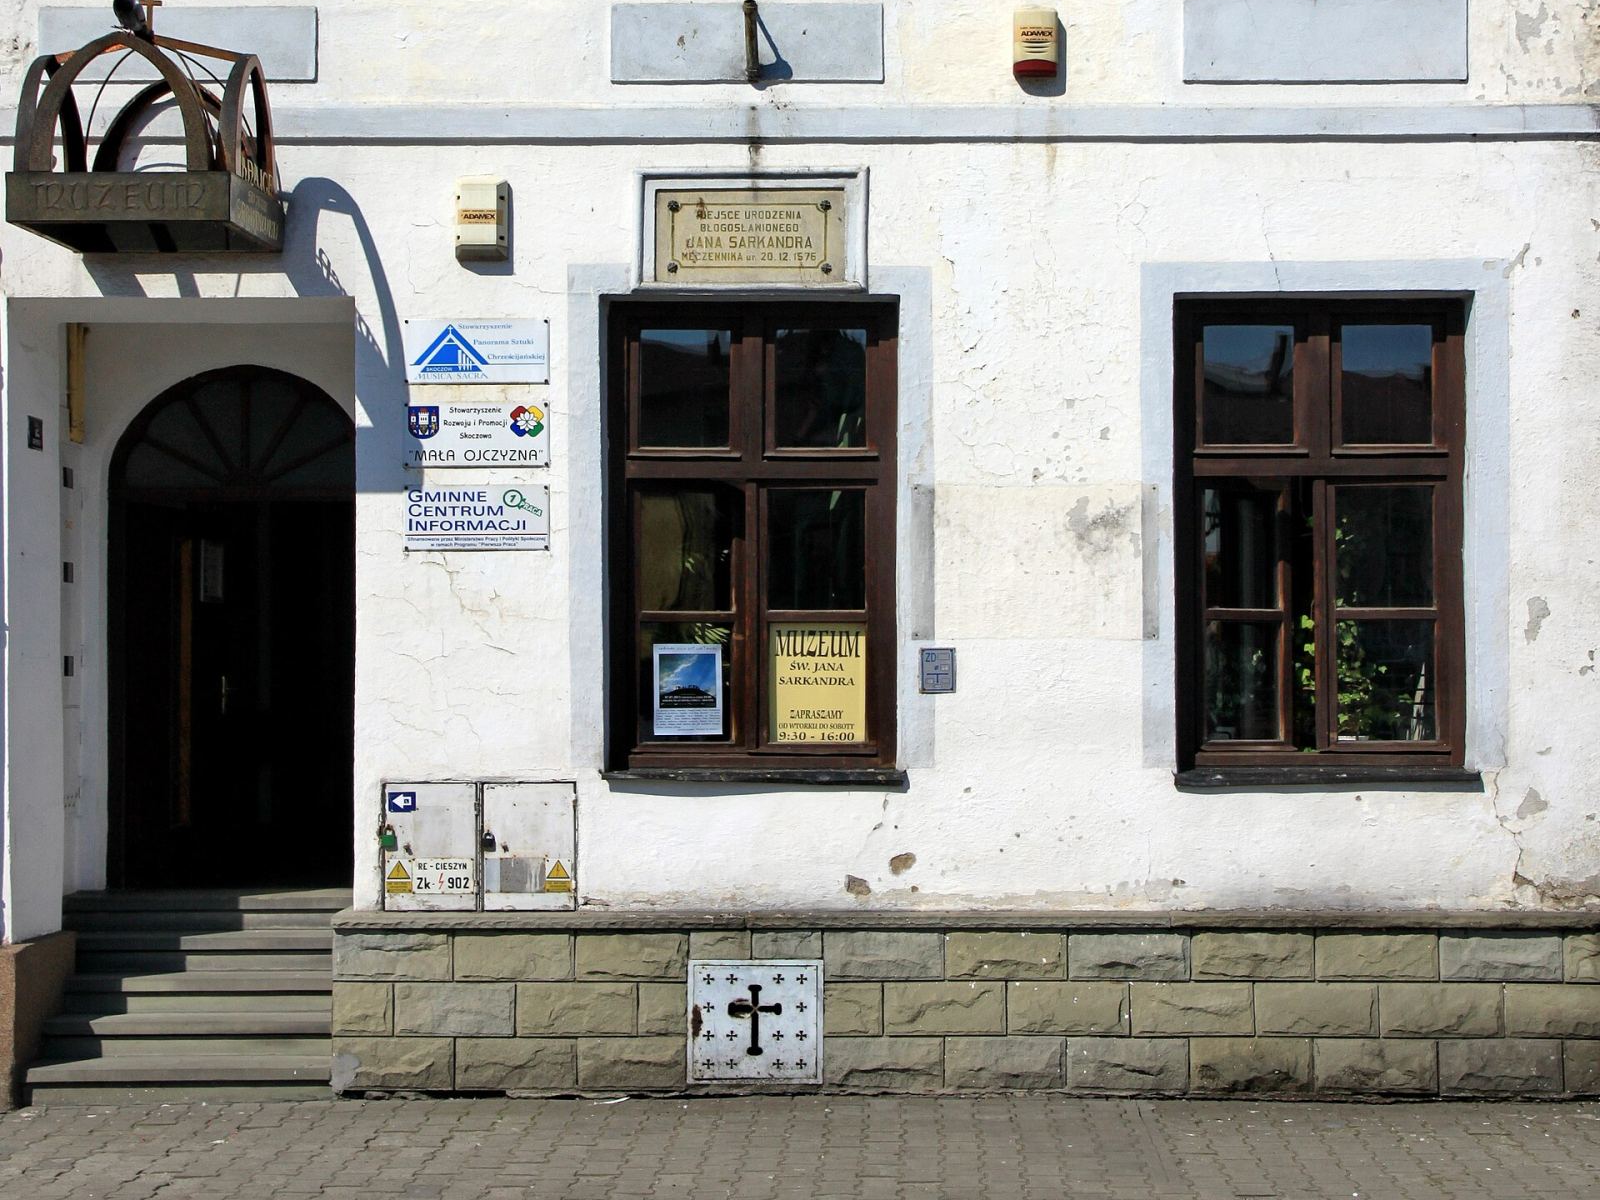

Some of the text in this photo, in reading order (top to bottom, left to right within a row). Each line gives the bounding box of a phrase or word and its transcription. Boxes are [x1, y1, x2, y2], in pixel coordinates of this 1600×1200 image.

[31, 180, 207, 212] MUZEUM
[744, 210, 802, 220] URODZENIA
[700, 223, 799, 232] BŁOGOSŁAWIONEGO
[686, 235, 813, 249] JANA SARKANDRA
[458, 323, 512, 331] Stowarzyszenie
[473, 338, 534, 346] Panorama Sztuki
[456, 372, 489, 380] SACRA
[449, 406, 502, 415] Stowarzyszenie
[443, 419, 472, 428] Rozwoju
[478, 419, 508, 428] Promocji
[408, 489, 487, 503] GMINNE
[408, 504, 504, 517] CENTRUM
[408, 518, 526, 531] INFORMACJI
[775, 629, 861, 658] MUZEUM
[924, 652, 937, 663] ZD
[789, 660, 844, 673] ŚW. JANA
[778, 676, 855, 686] SARKANDRA
[789, 709, 844, 720] ZAPRASZAMY
[789, 722, 818, 730] WTORKU
[778, 731, 807, 741] 9:30
[820, 731, 855, 742] 16:00
[435, 862, 468, 870] CIESZYN
[447, 876, 470, 890] 902
